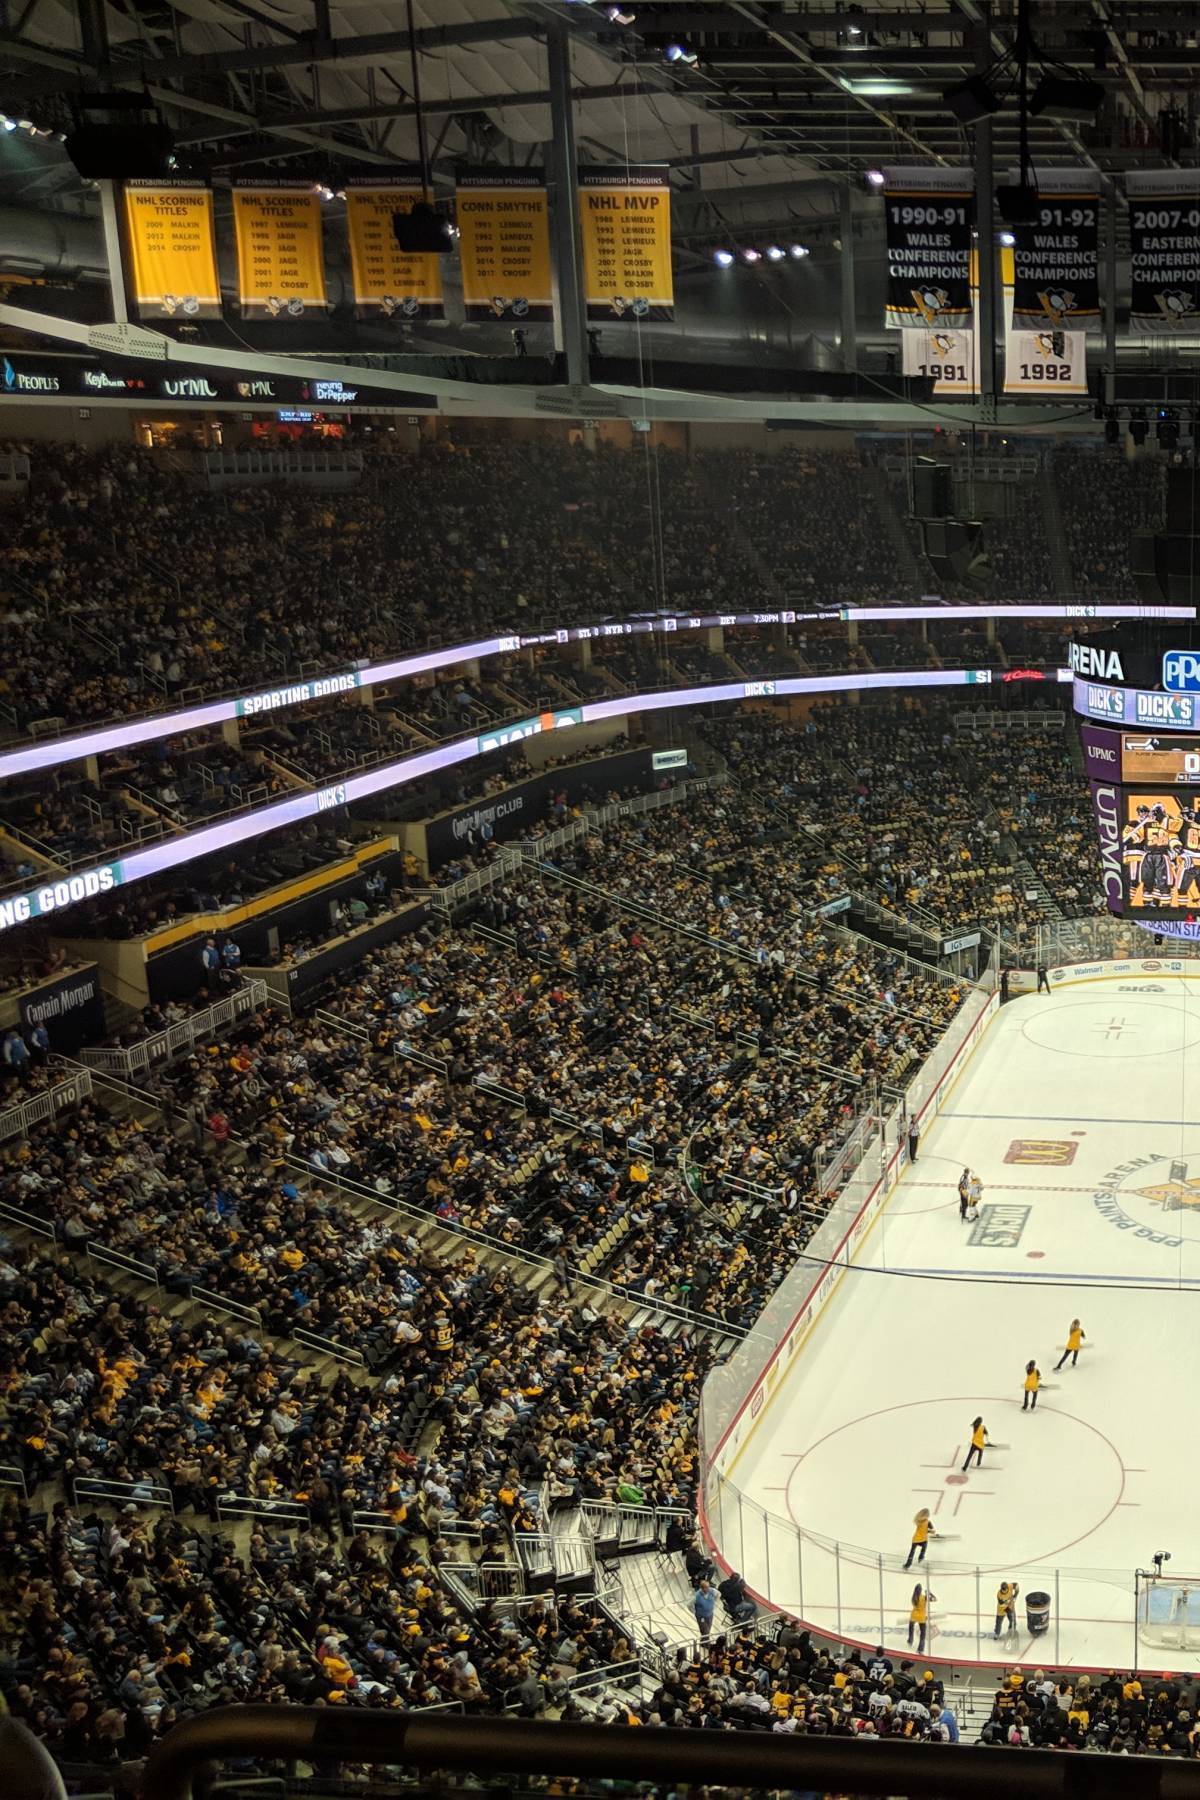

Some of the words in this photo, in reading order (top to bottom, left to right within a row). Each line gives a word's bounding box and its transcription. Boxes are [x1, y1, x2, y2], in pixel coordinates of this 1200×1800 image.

[136, 197, 156, 206] NHL
[160, 197, 204, 206] SCORING
[242, 196, 262, 206] NHL
[266, 196, 311, 206] SCORING
[462, 202, 494, 212] CONN
[496, 202, 543, 212] SMYTHE
[588, 197, 621, 210] NHL
[624, 197, 660, 210] MVP
[155, 207, 188, 216] TITLES
[260, 207, 294, 216] TITLES
[891, 207, 966, 224] 1990-91
[907, 233, 951, 246] WALES
[1034, 235, 1078, 248] WALES
[888, 249, 969, 263] CONFERENCE
[1015, 251, 1098, 264] CONFERENCE
[890, 266, 968, 279] CHAMPIONS
[1017, 266, 1096, 280] CHAMPIONS
[918, 365, 968, 381] 1991
[1020, 364, 1072, 381] 1992
[18, 374, 59, 390] PEOPLES
[317, 390, 358, 402] DrPepper
[1066, 606, 1096, 617] DICK'S
[578, 630, 592, 638] STL
[604, 625, 624, 635] NYR
[720, 616, 736, 625] DET
[754, 614, 779, 624] 7:30PM
[1068, 642, 1124, 680] ARENA
[244, 684, 311, 714] SPORTING
[314, 674, 356, 697] GOODS
[744, 682, 776, 696] DICK'S
[1088, 685, 1122, 712] DICK'S
[1138, 694, 1192, 718] DICK'S
[1088, 746, 1117, 762] UPMC
[1184, 754, 1200, 773] 0
[318, 784, 346, 811] DICK'S
[496, 796, 524, 816] CLUB
[1096, 788, 1123, 900] UPMC
[40, 867, 114, 912] GOODS
[1074, 966, 1104, 976] Walmart
[26, 998, 60, 1024] Captain
[60, 981, 94, 1017] Morgan
[238, 996, 250, 1012] 111
[152, 1040, 166, 1054] 111
[57, 1088, 76, 1107] 110
[1098, 1152, 1168, 1188] ARENA
[1094, 1192, 1137, 1230] PAINTS
[1134, 1229, 1184, 1248] PPG
[869, 1668, 887, 1680] 87
